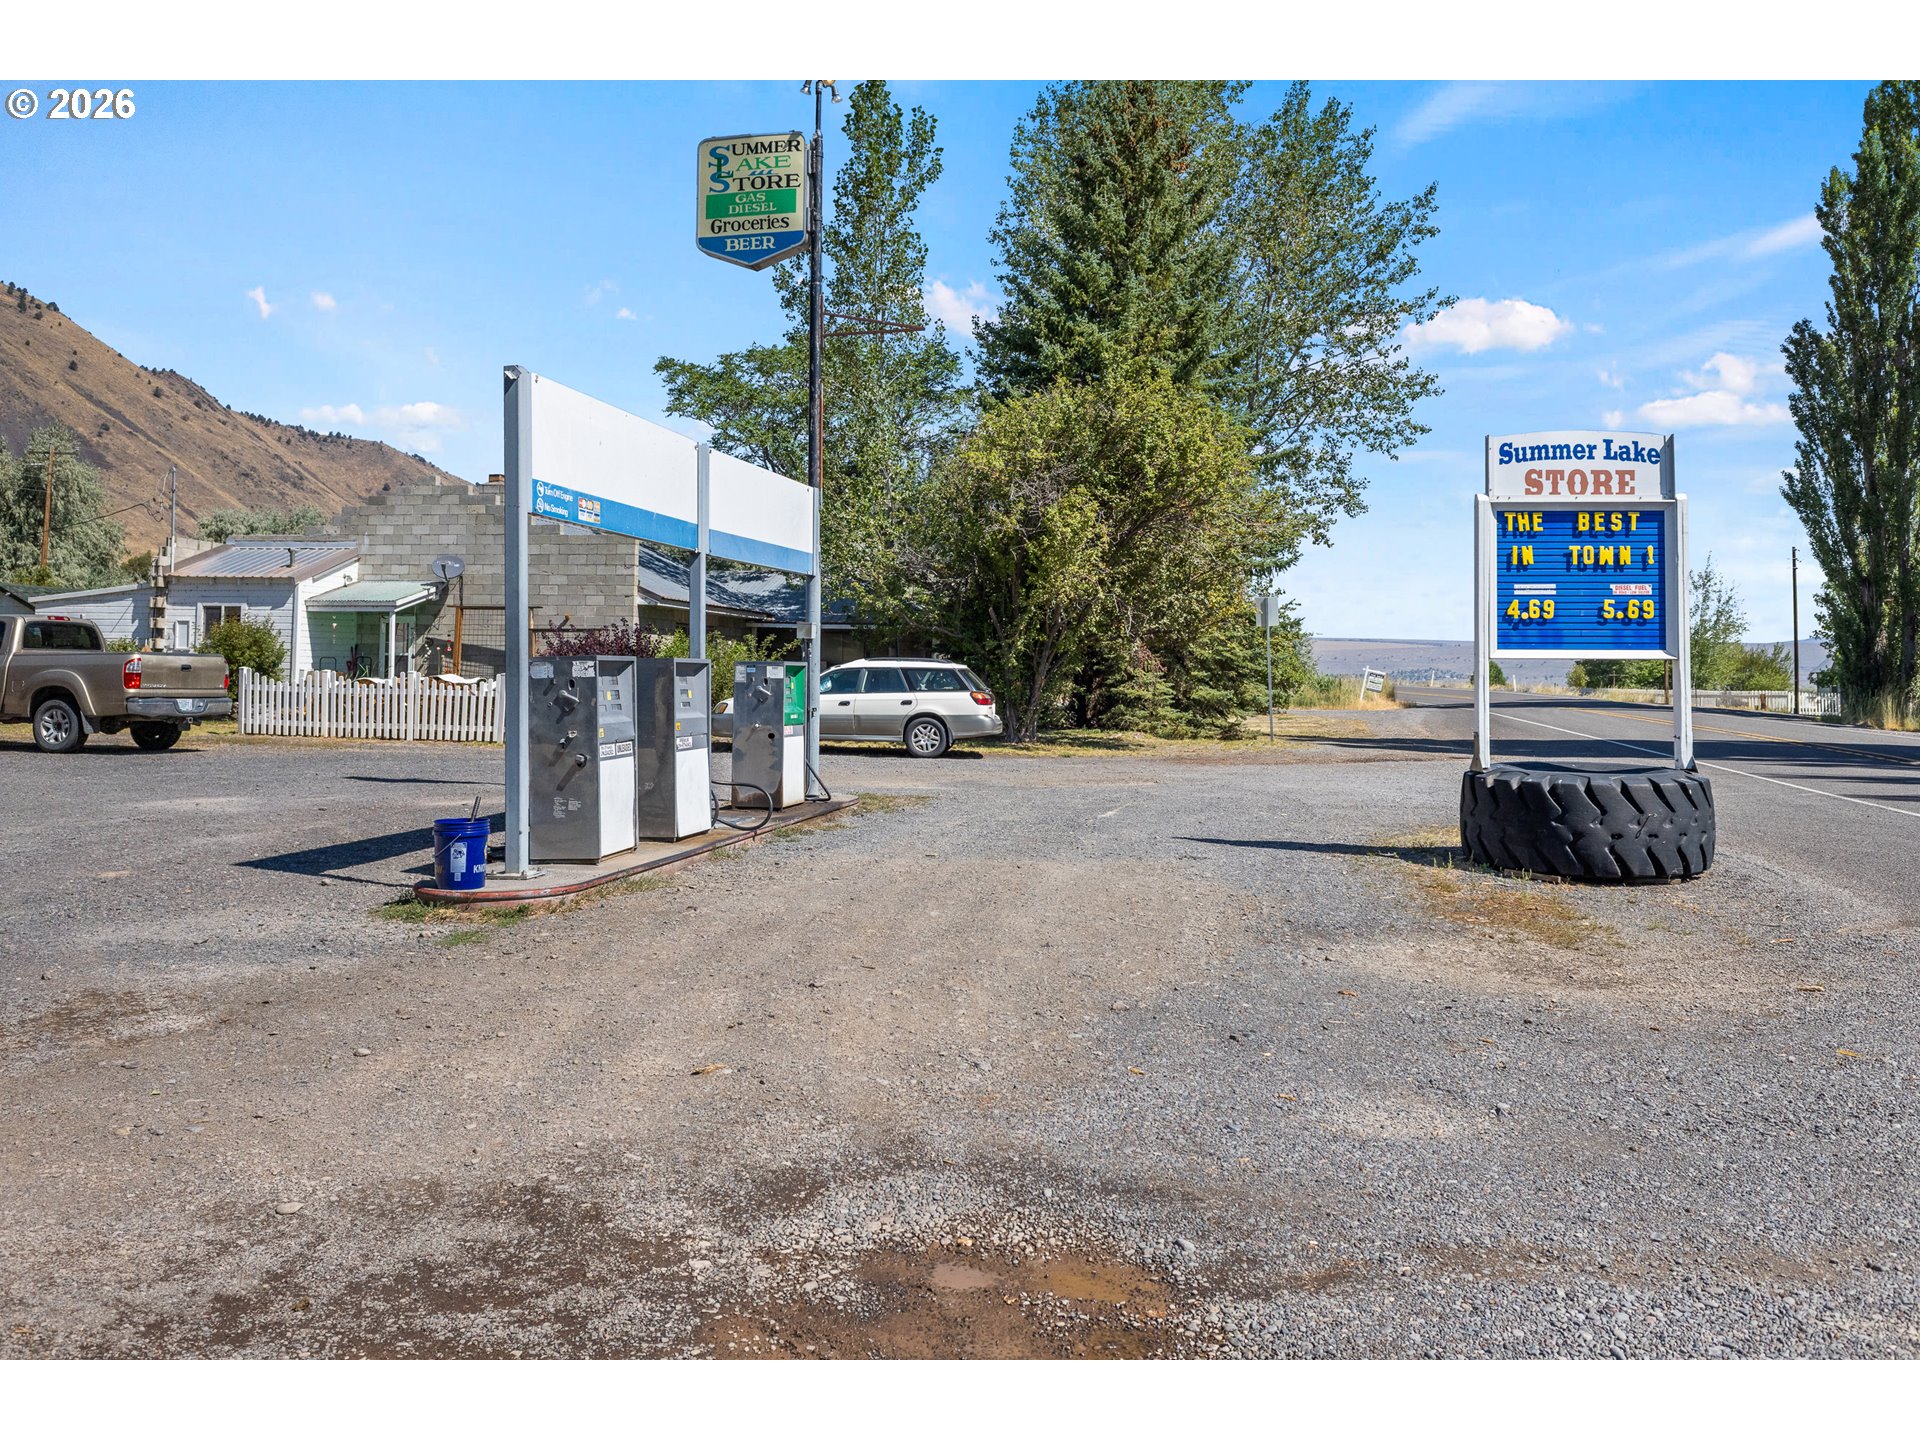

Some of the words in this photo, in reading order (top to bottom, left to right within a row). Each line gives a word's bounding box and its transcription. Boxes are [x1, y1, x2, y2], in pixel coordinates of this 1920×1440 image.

[708, 139, 802, 169] SUMMER
[708, 170, 802, 193] STORE
[735, 192, 766, 204] GAS
[728, 202, 777, 215] DIESEL
[710, 215, 790, 235] Groceries
[724, 235, 776, 252] BEER
[1499, 442, 1597, 465] Summer
[1602, 438, 1661, 465] Lake
[1524, 469, 1636, 496] STORE
[1504, 511, 1544, 532] THE
[1577, 511, 1640, 531] BEST
[1511, 545, 1534, 565] IN
[1568, 545, 1632, 565] TOWN
[1507, 599, 1555, 619] 4.69
[1603, 599, 1655, 619] 5.69
